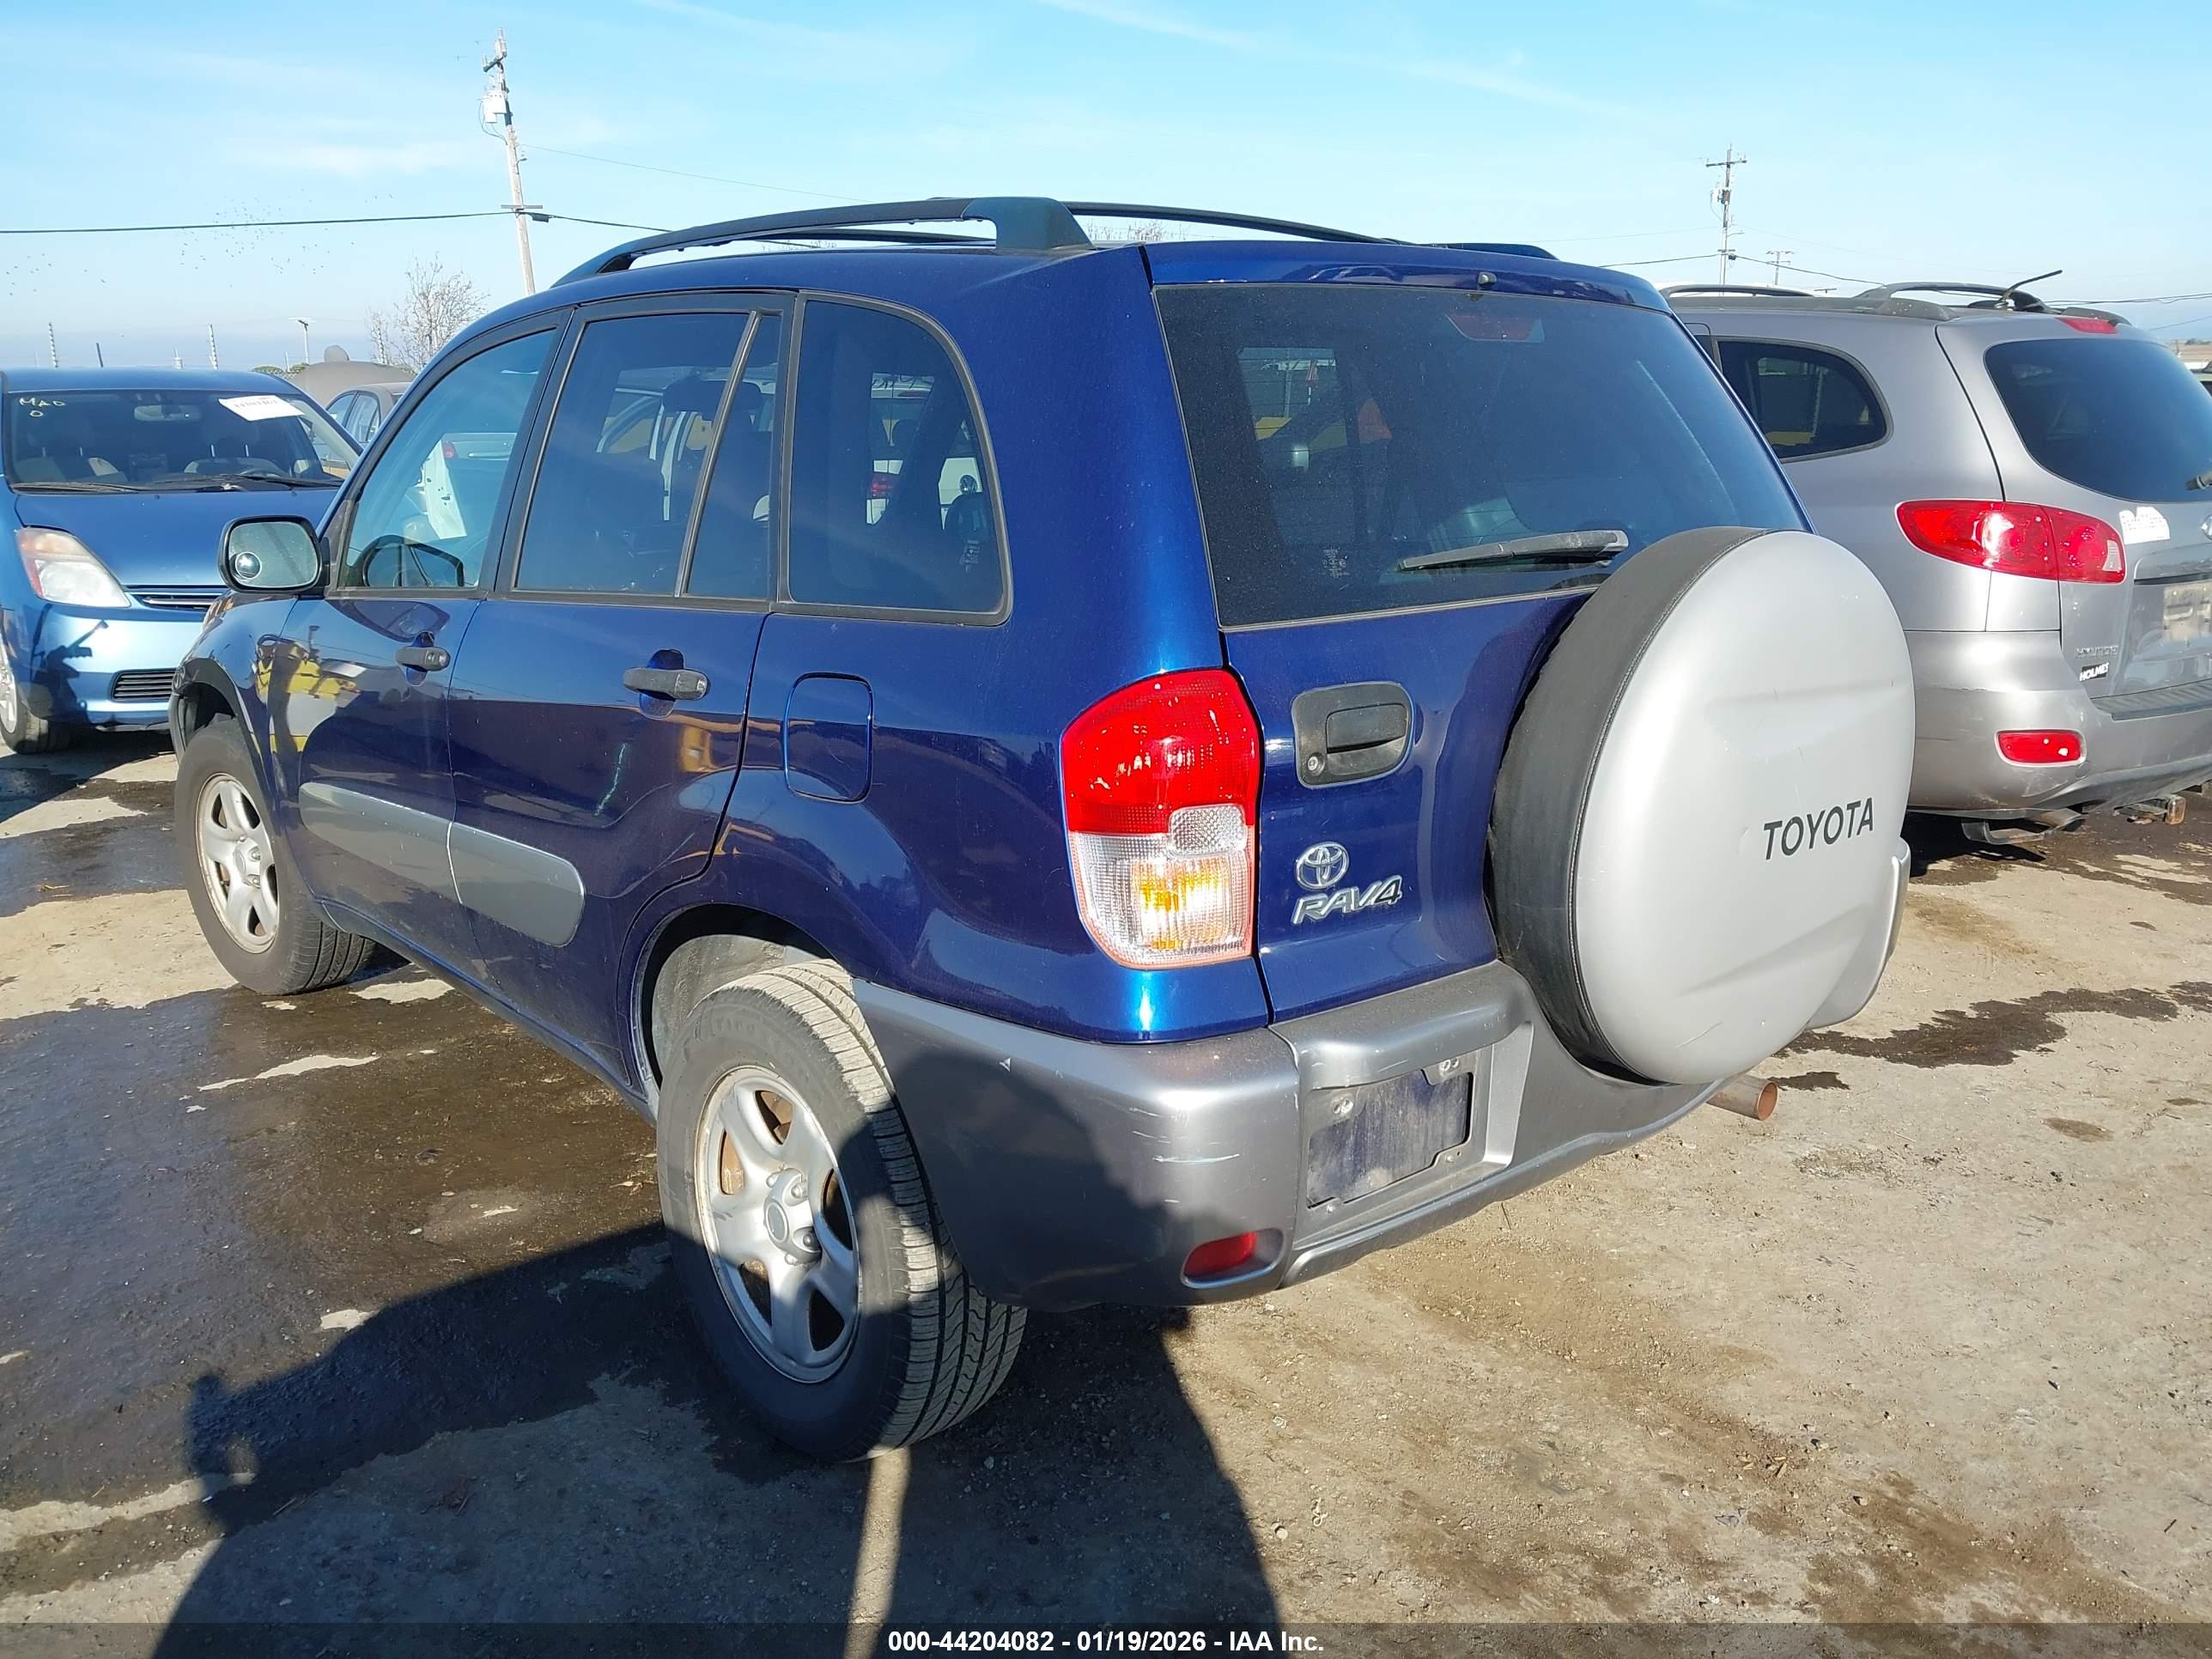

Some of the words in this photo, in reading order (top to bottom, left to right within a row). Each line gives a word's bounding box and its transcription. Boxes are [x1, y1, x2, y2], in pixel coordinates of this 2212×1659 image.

[2079, 662, 2109, 682] HOLMES
[1763, 797, 1874, 860] TOYOTA
[1291, 874, 1403, 925] RAV4
